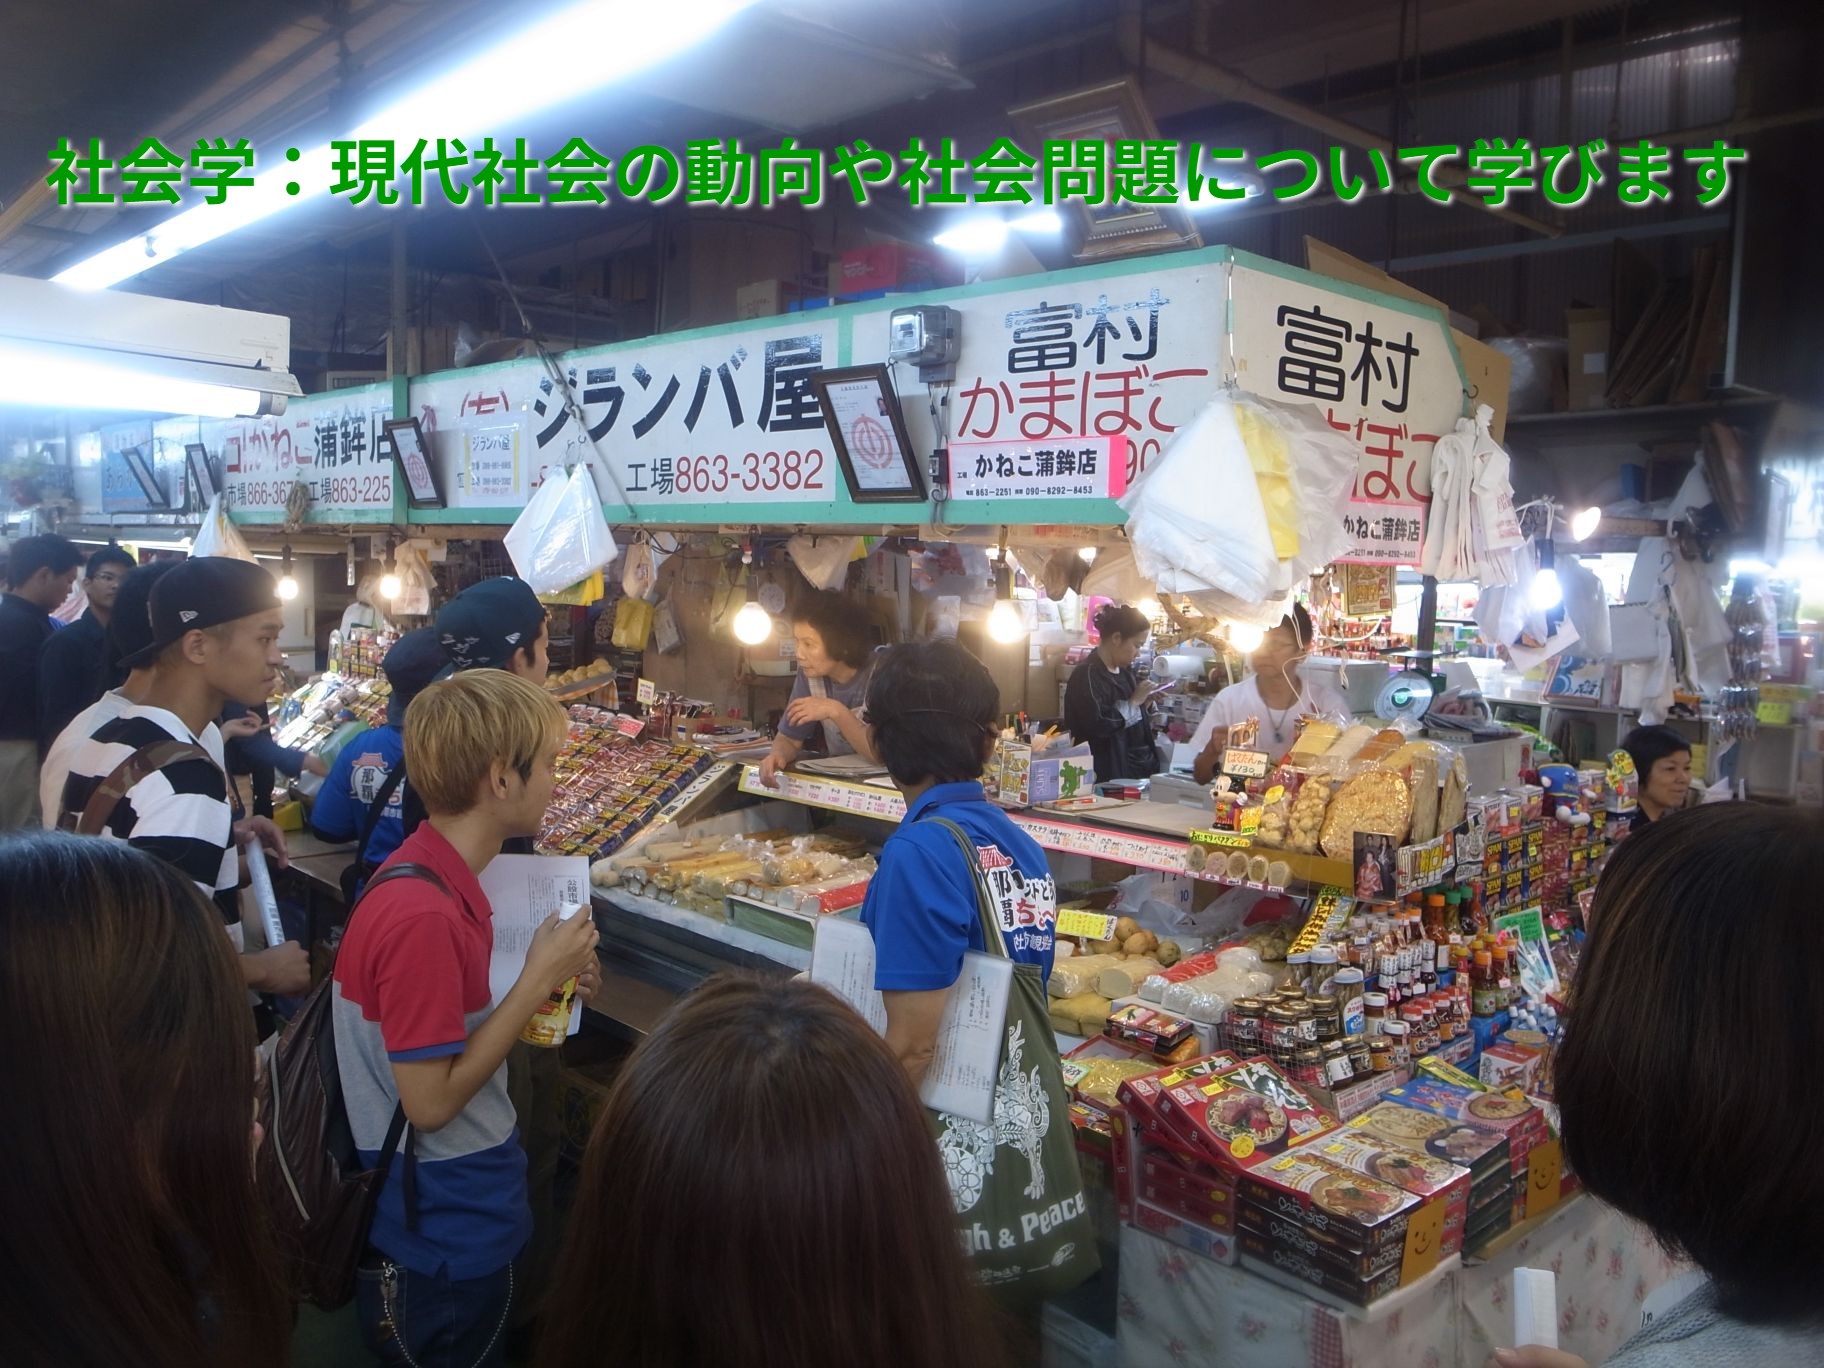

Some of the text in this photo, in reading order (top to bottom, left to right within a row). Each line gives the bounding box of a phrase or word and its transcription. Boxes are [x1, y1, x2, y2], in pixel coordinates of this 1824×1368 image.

[1005, 288, 1171, 374] 富村
[1277, 305, 1420, 413] 富村
[533, 334, 825, 450] ジランバ屋
[958, 364, 1209, 440] かまぼこ
[625, 449, 824, 496] 工場863-3382
[974, 449, 1098, 479] かねこ蒲鉾店
[1327, 407, 1442, 504] ぼこ
[956, 1191, 1087, 1256] gh & Peace
